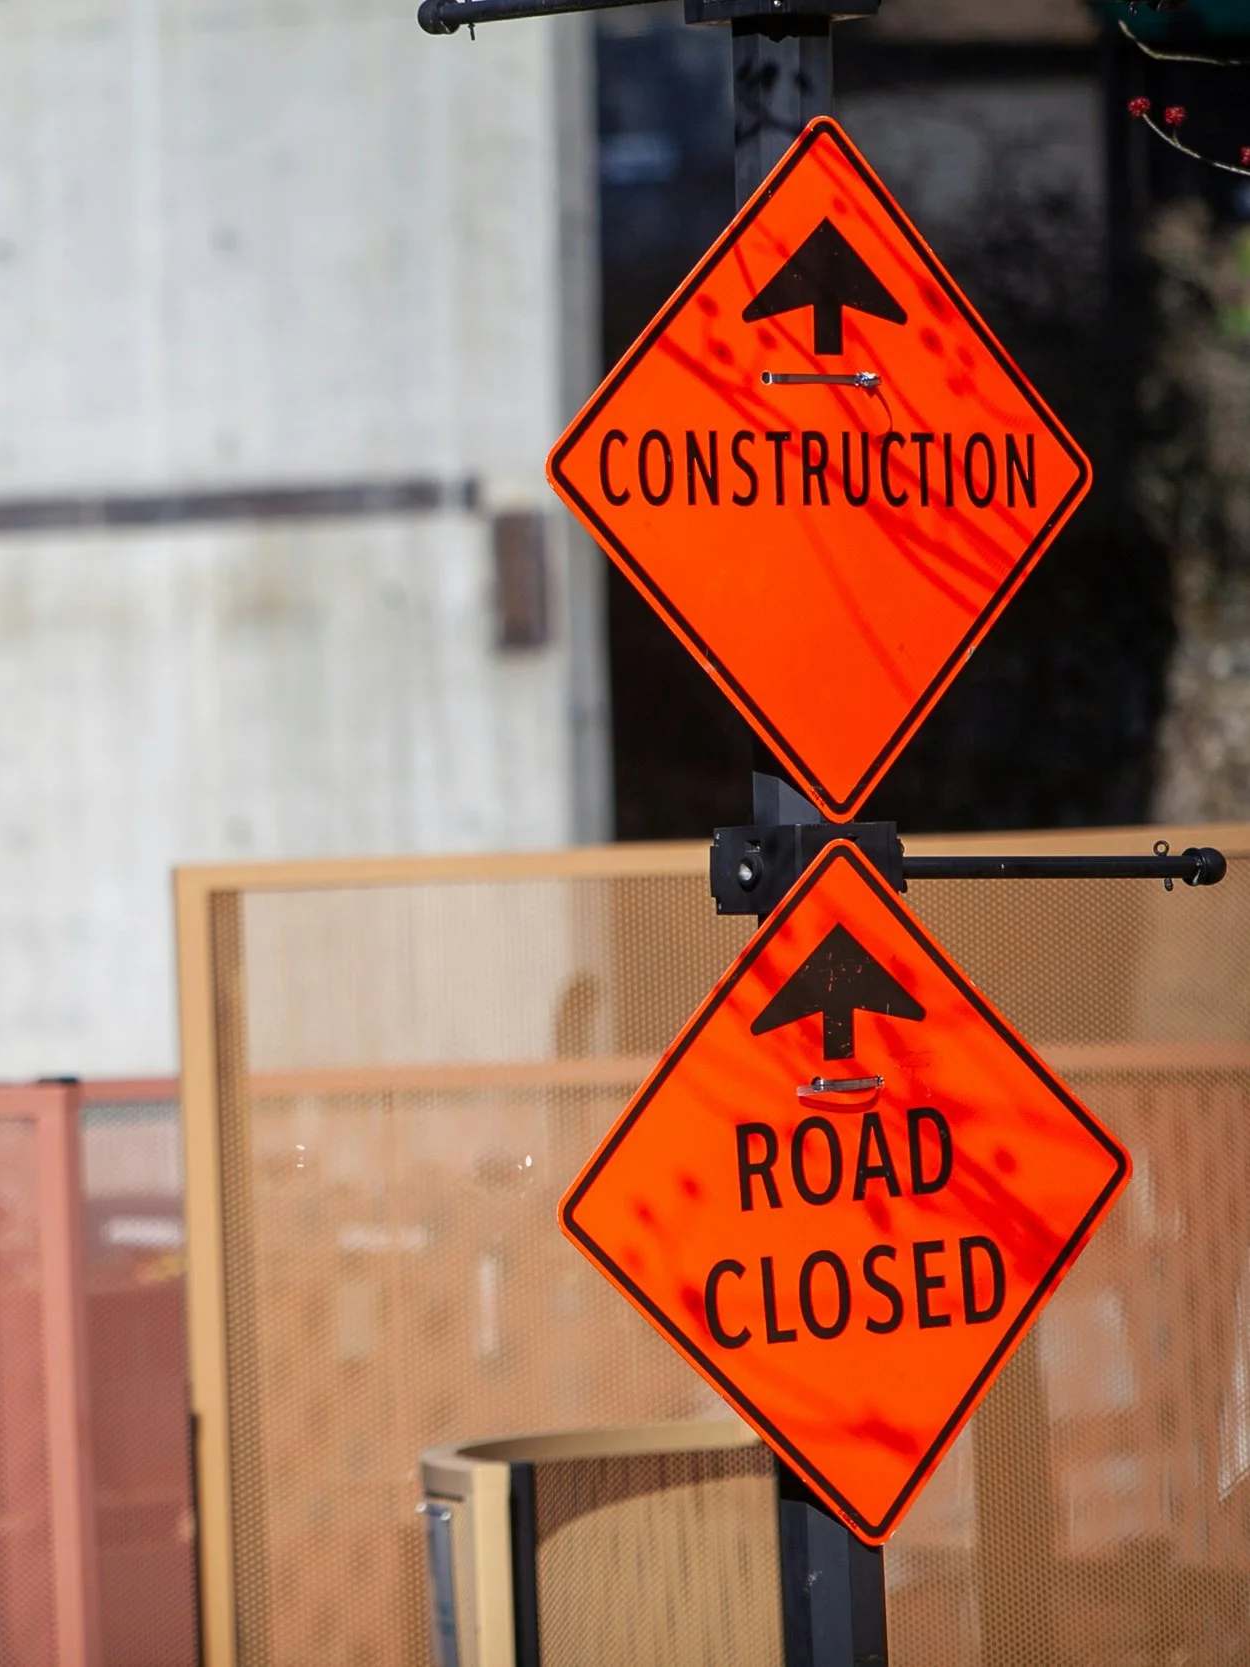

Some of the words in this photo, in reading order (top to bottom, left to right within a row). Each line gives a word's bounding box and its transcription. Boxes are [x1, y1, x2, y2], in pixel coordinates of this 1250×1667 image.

[600, 429, 1036, 508] CONSTRUCTION
[736, 1107, 953, 1210] ROAD
[705, 1236, 1006, 1348] CLOSED
